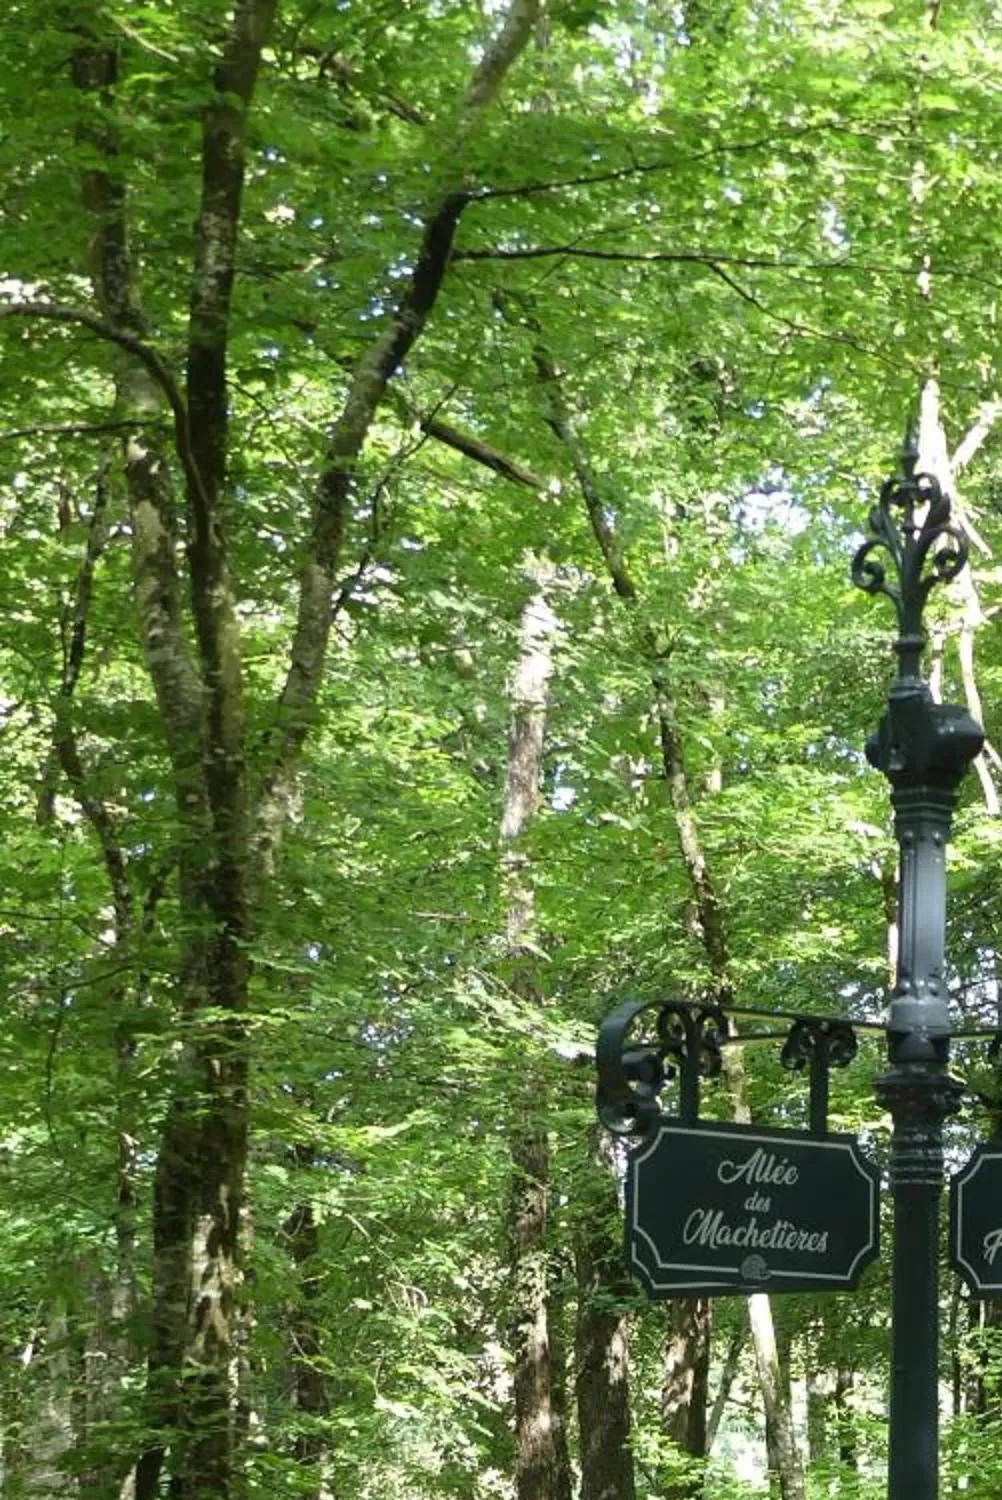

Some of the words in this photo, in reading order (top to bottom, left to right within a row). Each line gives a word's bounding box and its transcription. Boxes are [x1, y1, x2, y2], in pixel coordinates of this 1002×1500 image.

[717, 1148, 799, 1185] Allée
[744, 1191, 772, 1213] des
[683, 1208, 829, 1252] Machetières
